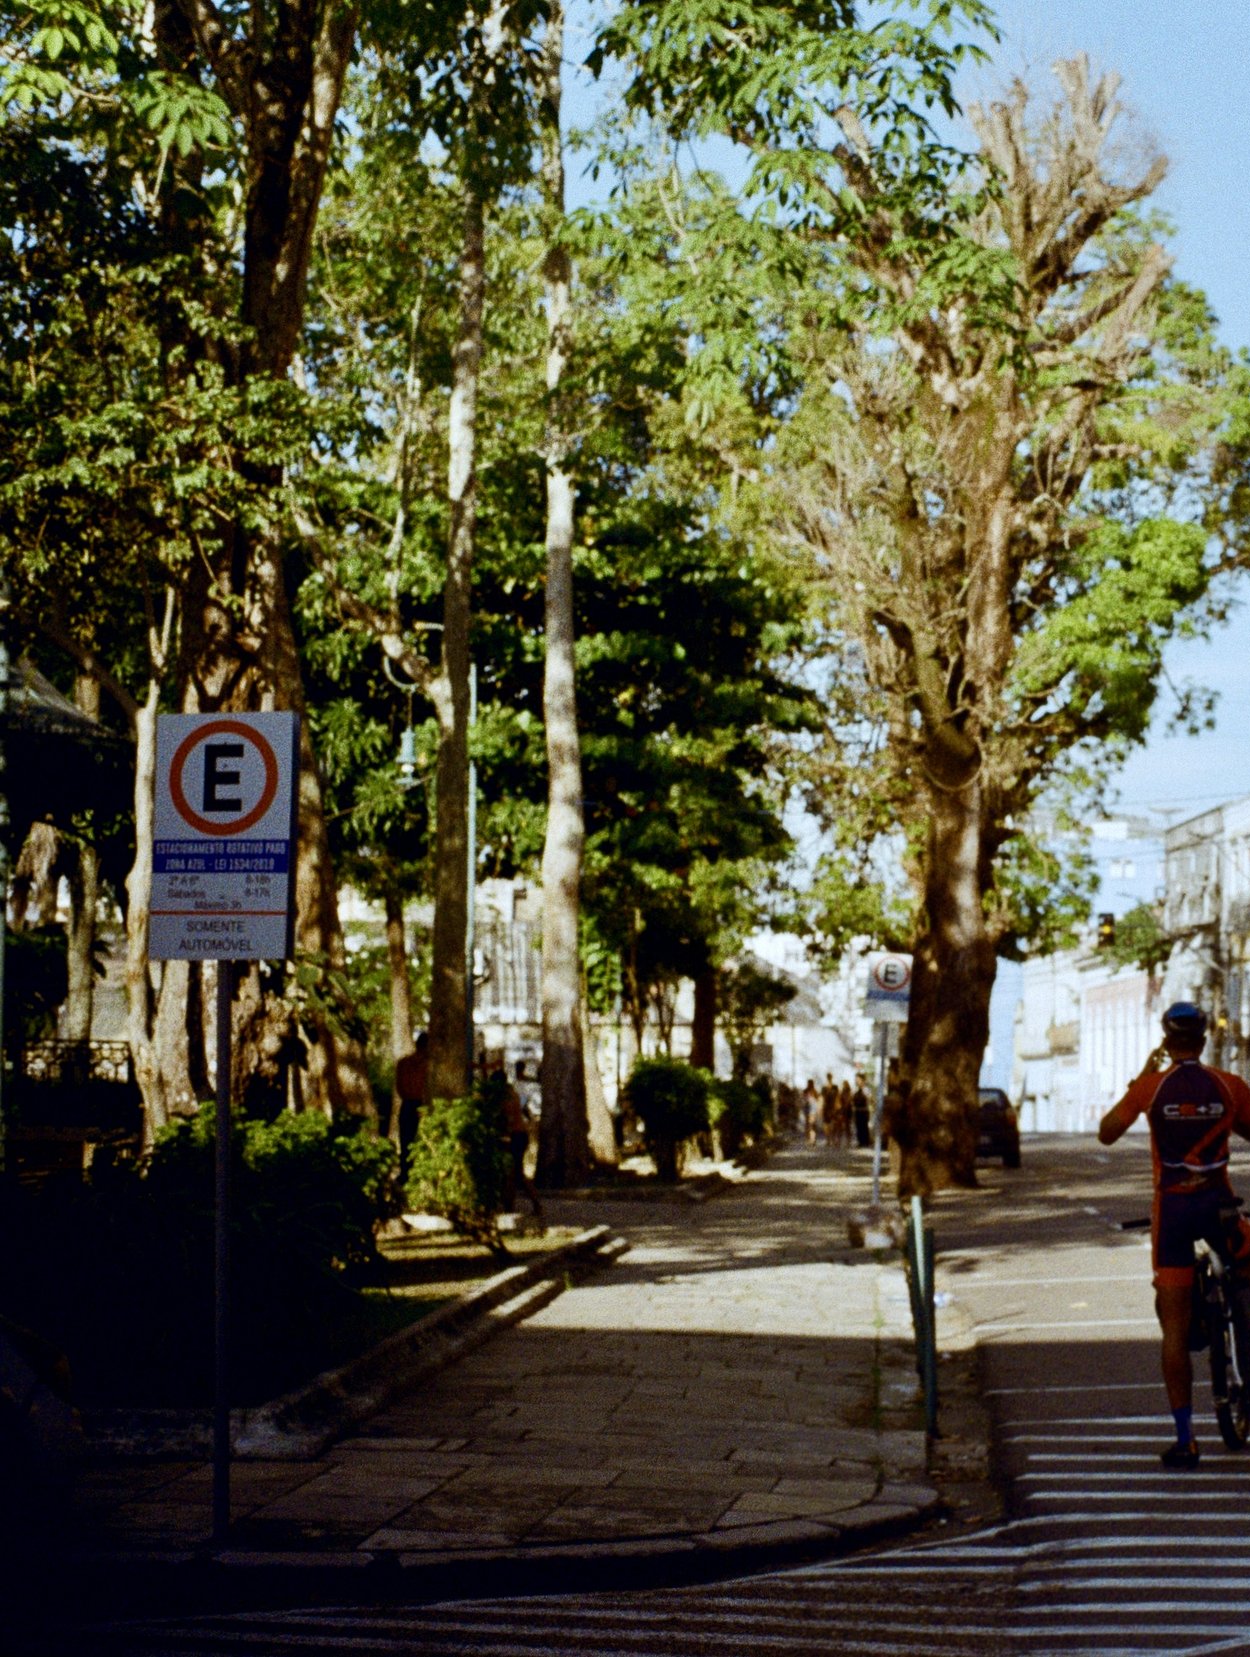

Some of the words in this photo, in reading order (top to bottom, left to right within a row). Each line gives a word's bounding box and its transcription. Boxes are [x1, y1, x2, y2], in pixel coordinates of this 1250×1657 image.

[203, 744, 244, 812] E
[156, 842, 224, 854] ESTACIONAMENTO
[226, 842, 263, 854] ROTATIVO
[265, 842, 286, 854] PAGO
[165, 858, 186, 870] ZONA
[187, 858, 206, 870] AZUL
[214, 858, 227, 870] LEI
[186, 920, 247, 932] SOMENTE
[179, 937, 253, 951] AUTOMÓVEL
[884, 963, 897, 983] E
